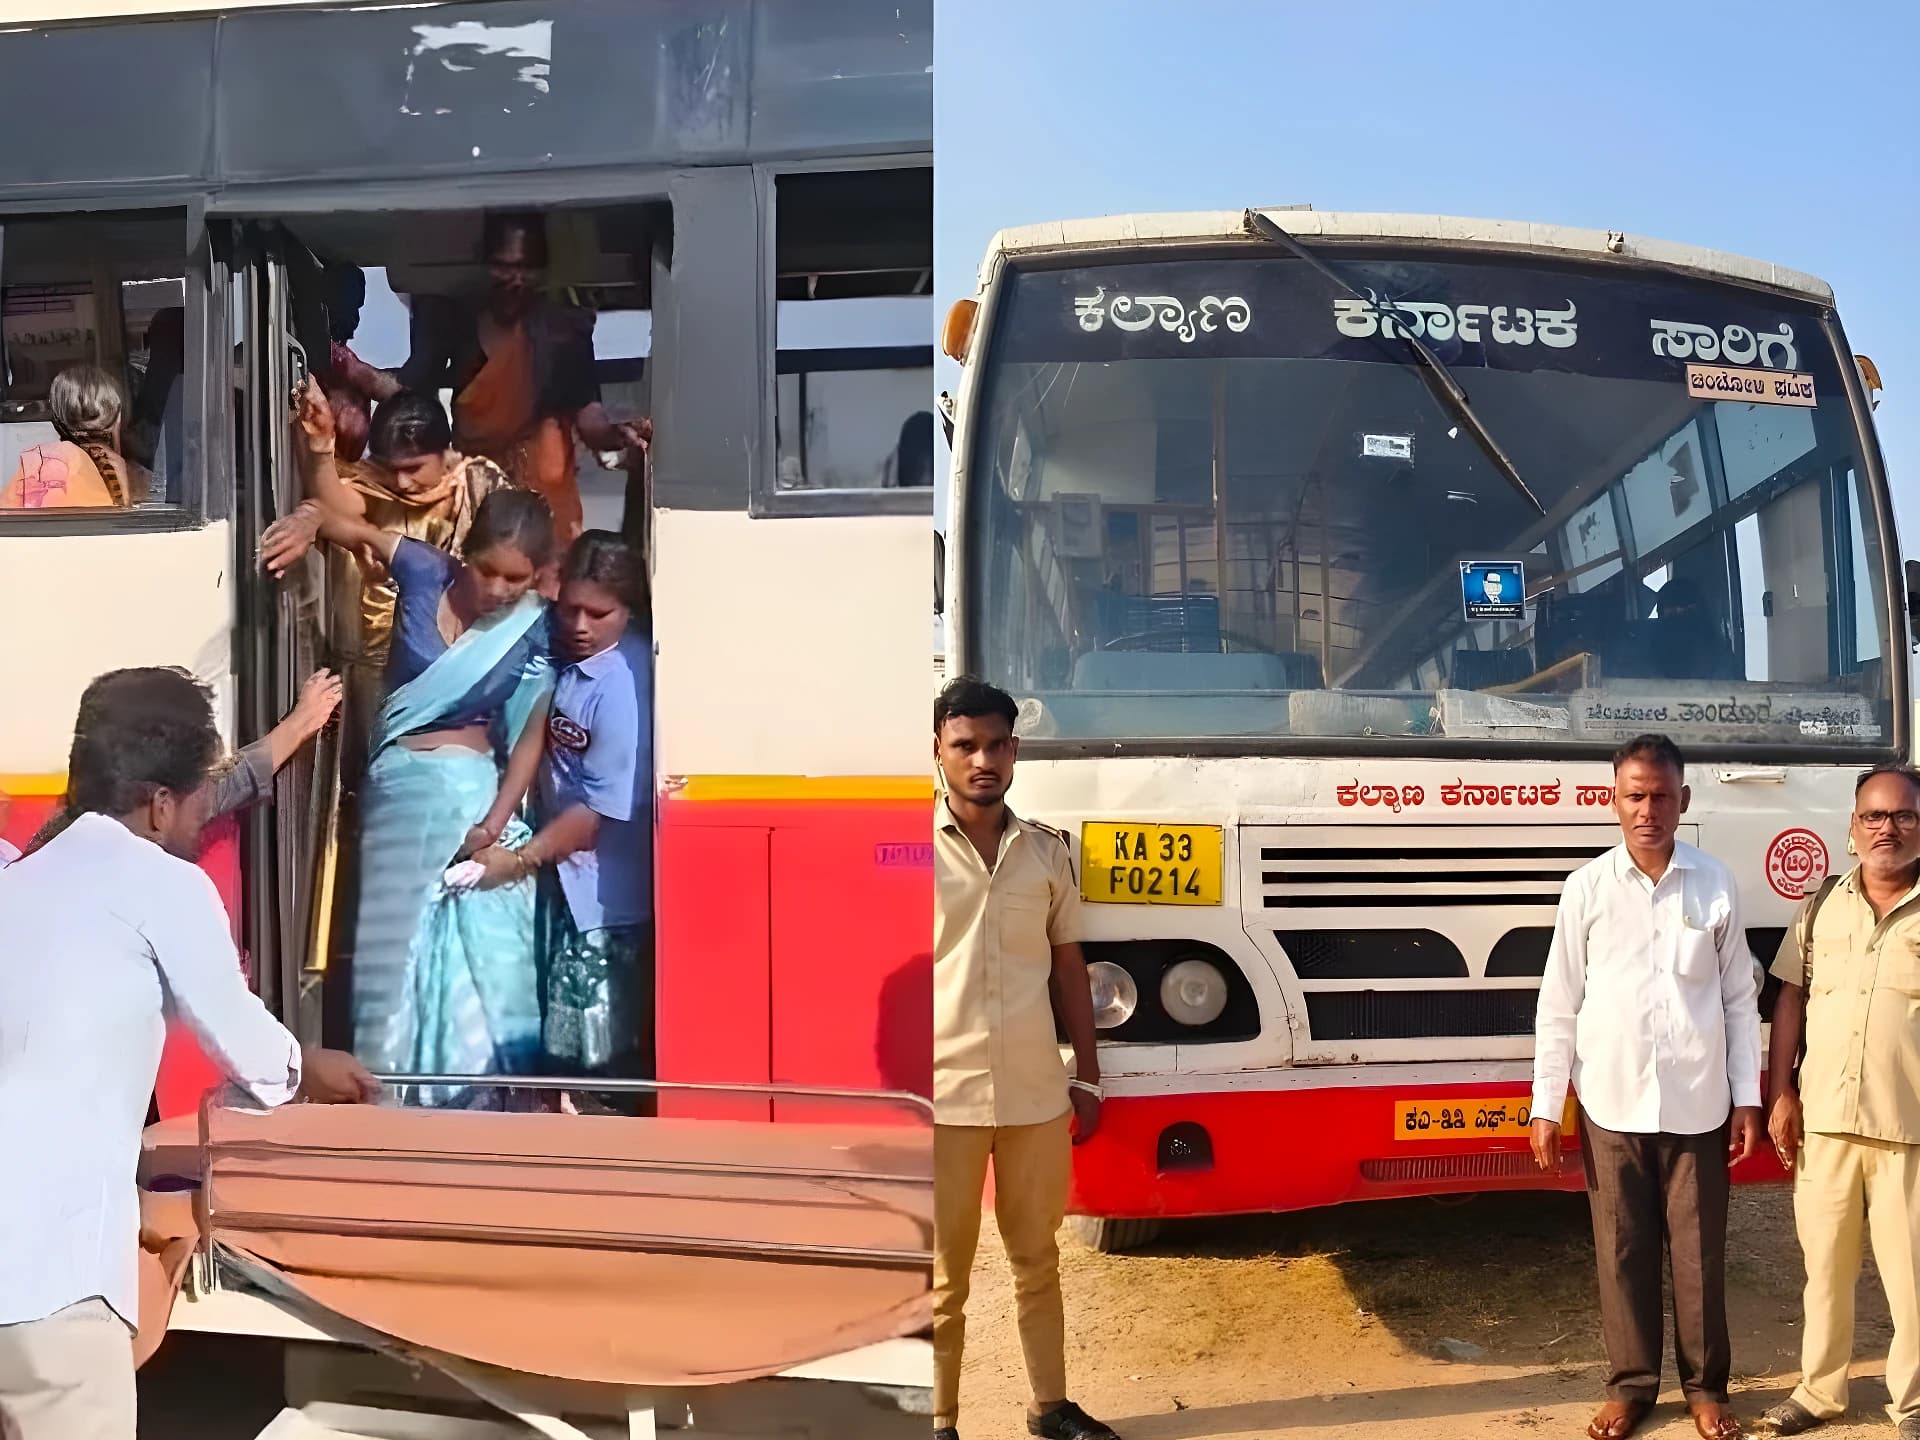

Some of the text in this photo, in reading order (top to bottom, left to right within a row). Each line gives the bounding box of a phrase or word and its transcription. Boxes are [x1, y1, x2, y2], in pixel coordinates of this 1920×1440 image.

[1075, 286, 1797, 370] ಕಲ್ಯಾಣ ಕರ್ನಾಟಕ ಸಾರಿಗೆ
[1336, 777, 1425, 813] ಕಲ್ಯಾಣ
[1440, 777, 1561, 806] ಕರ್ನಾಟಕ
[1115, 831, 1193, 862] KA 33
[1110, 866, 1200, 896] F0214
